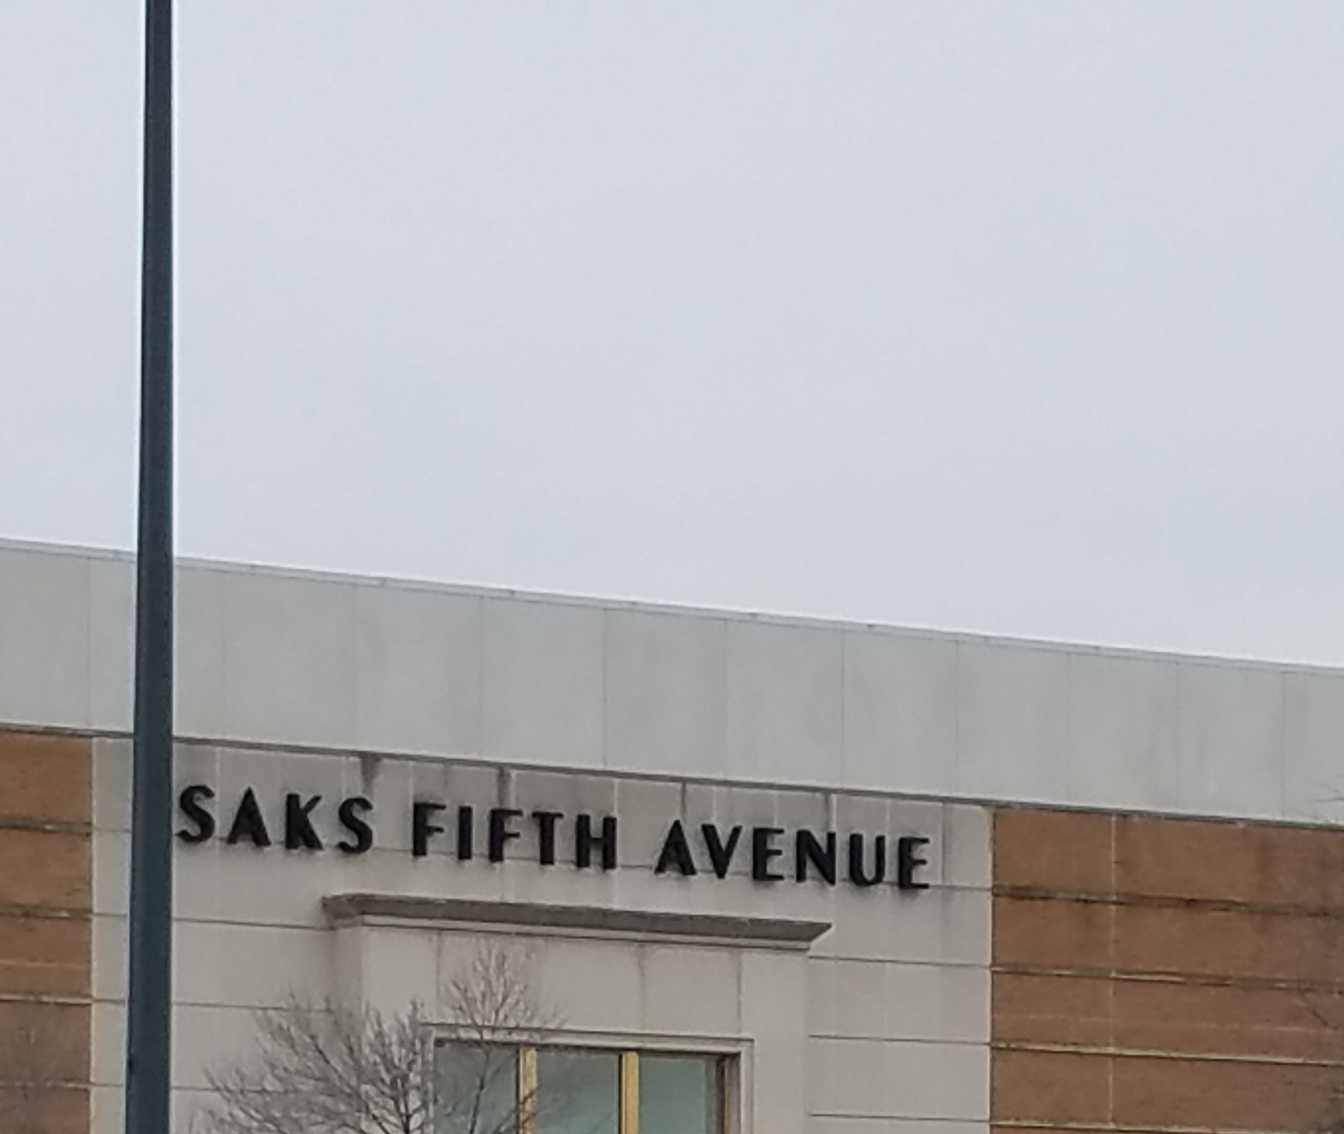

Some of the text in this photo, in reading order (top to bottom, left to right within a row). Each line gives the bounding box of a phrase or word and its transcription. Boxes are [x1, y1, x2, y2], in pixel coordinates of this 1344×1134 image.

[175, 784, 930, 889] SAKS FIFTH AVENUE
